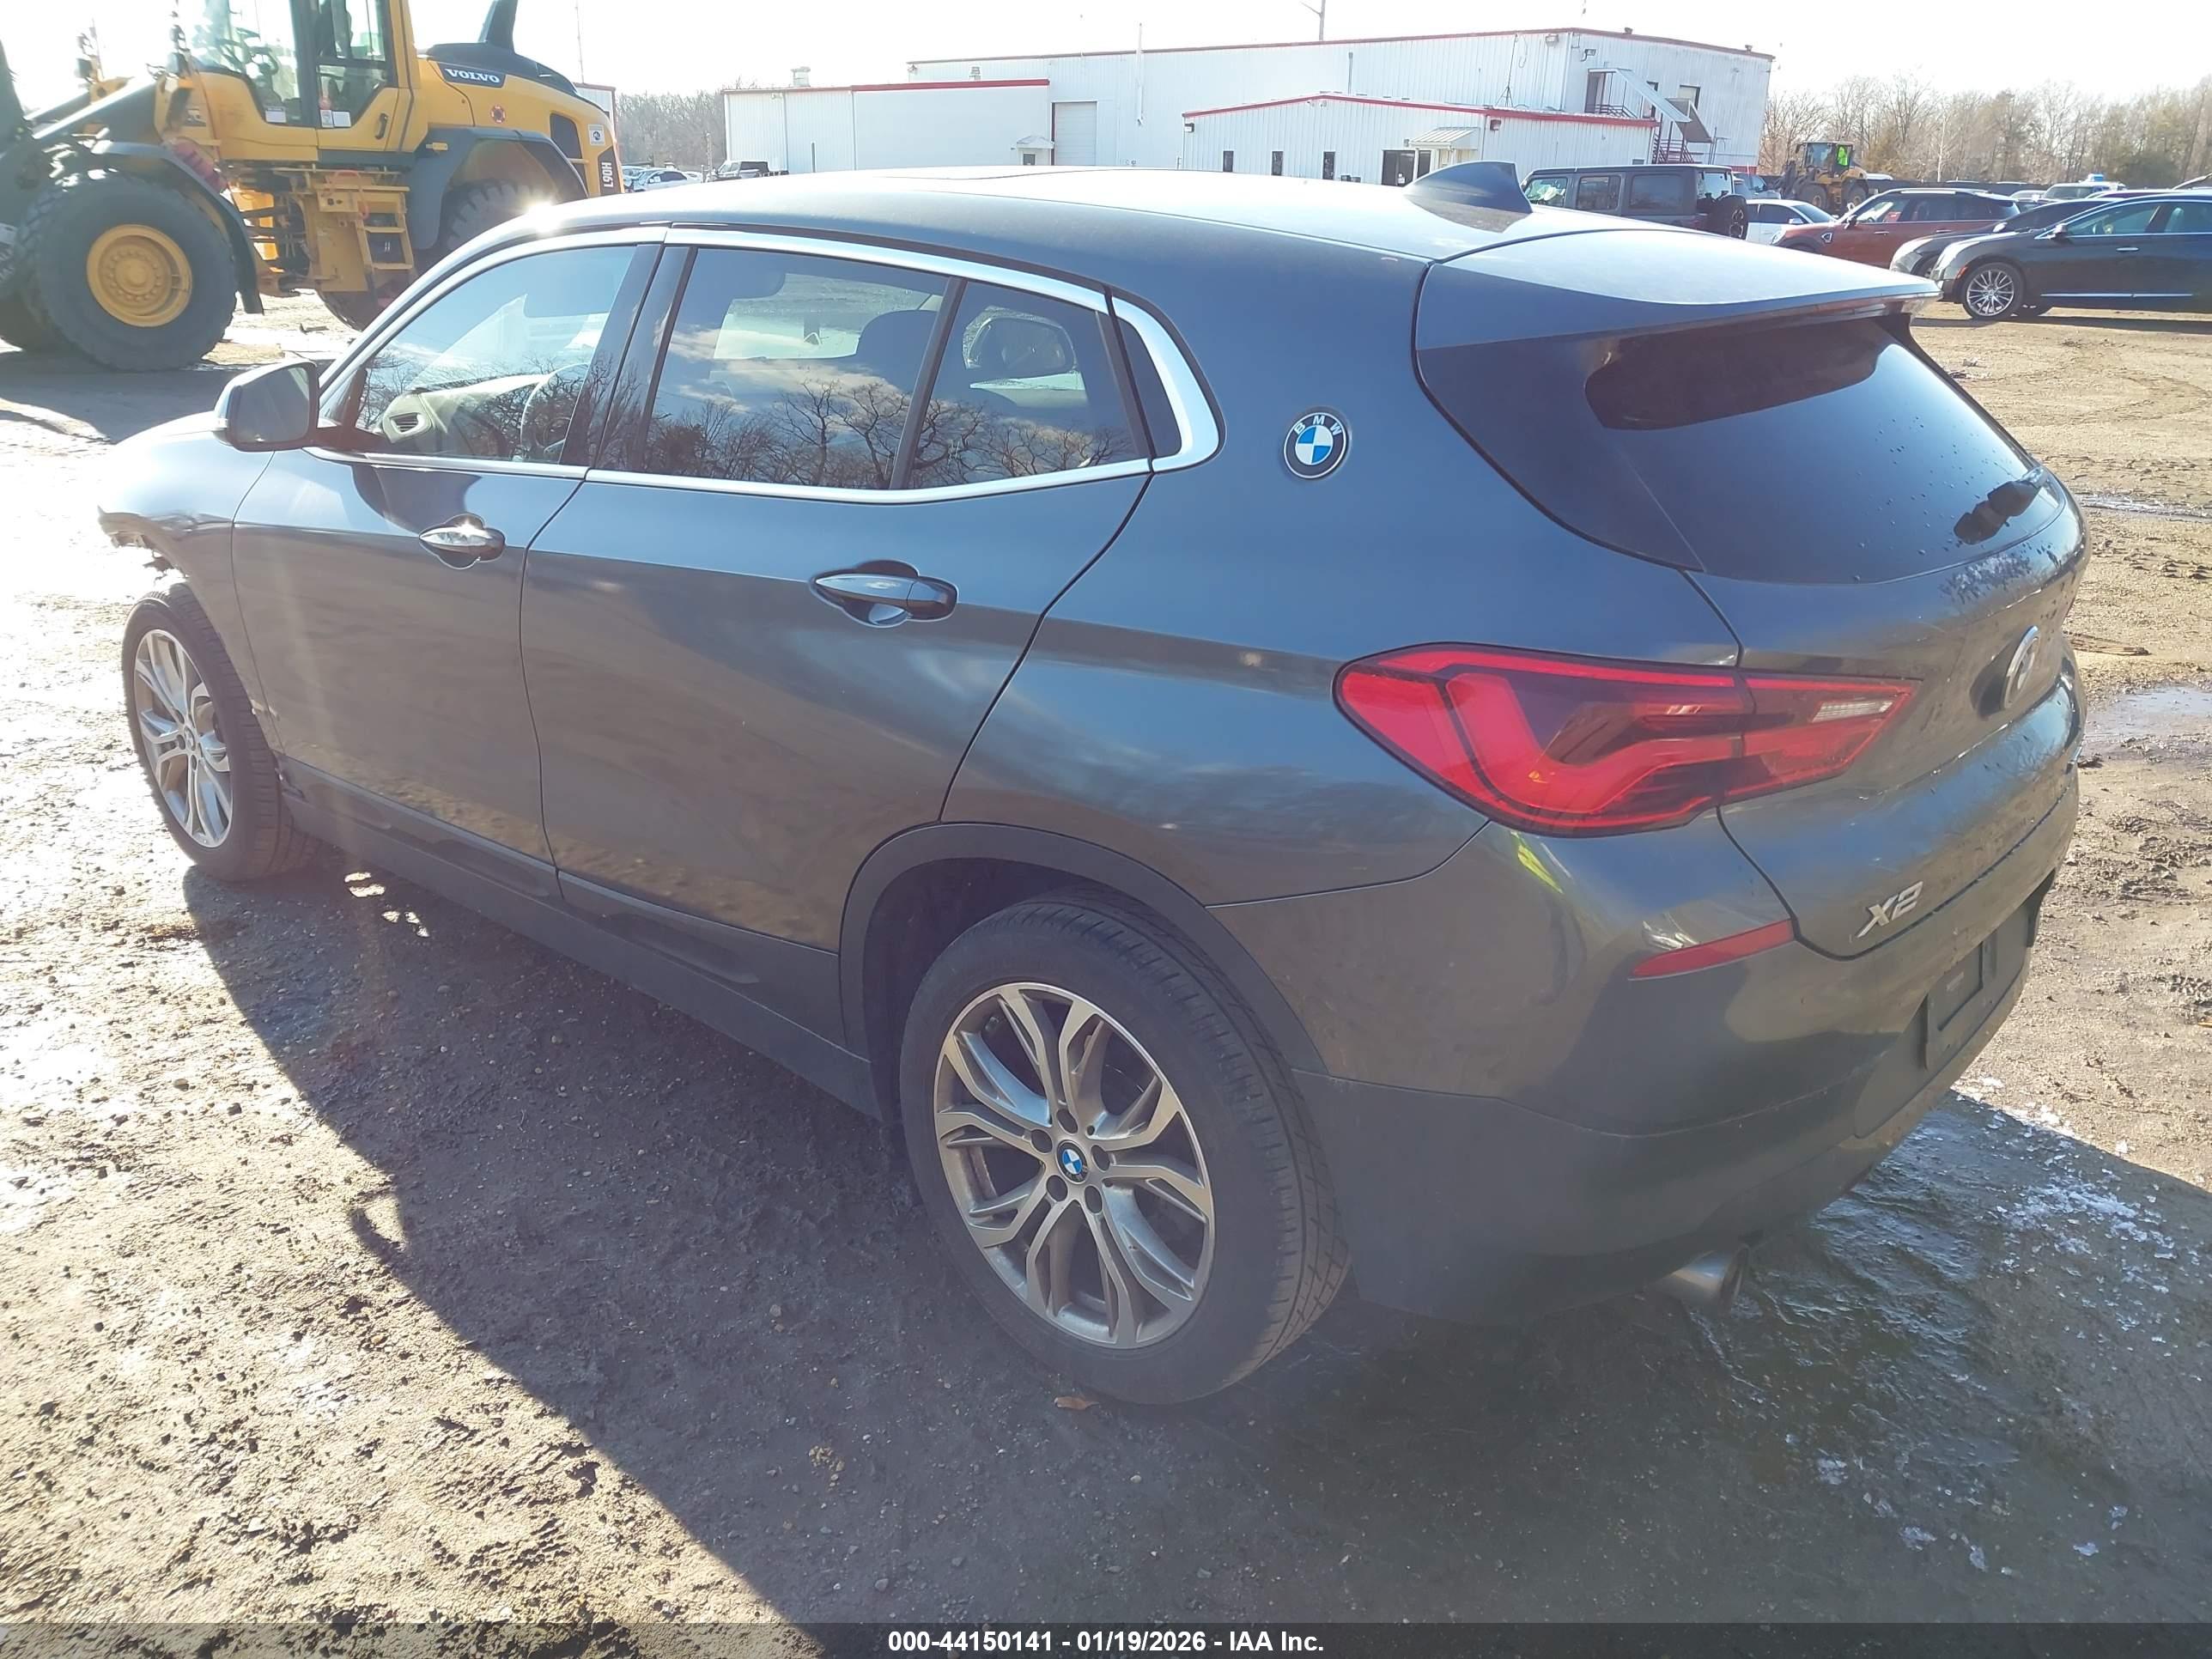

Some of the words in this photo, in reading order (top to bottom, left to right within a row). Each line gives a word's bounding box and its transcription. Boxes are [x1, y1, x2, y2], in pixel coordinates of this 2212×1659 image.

[445, 68, 500, 83] VOLVO
[601, 161, 614, 187] L90H
[1293, 415, 1342, 436] BMW
[1856, 880, 1923, 938] X2
